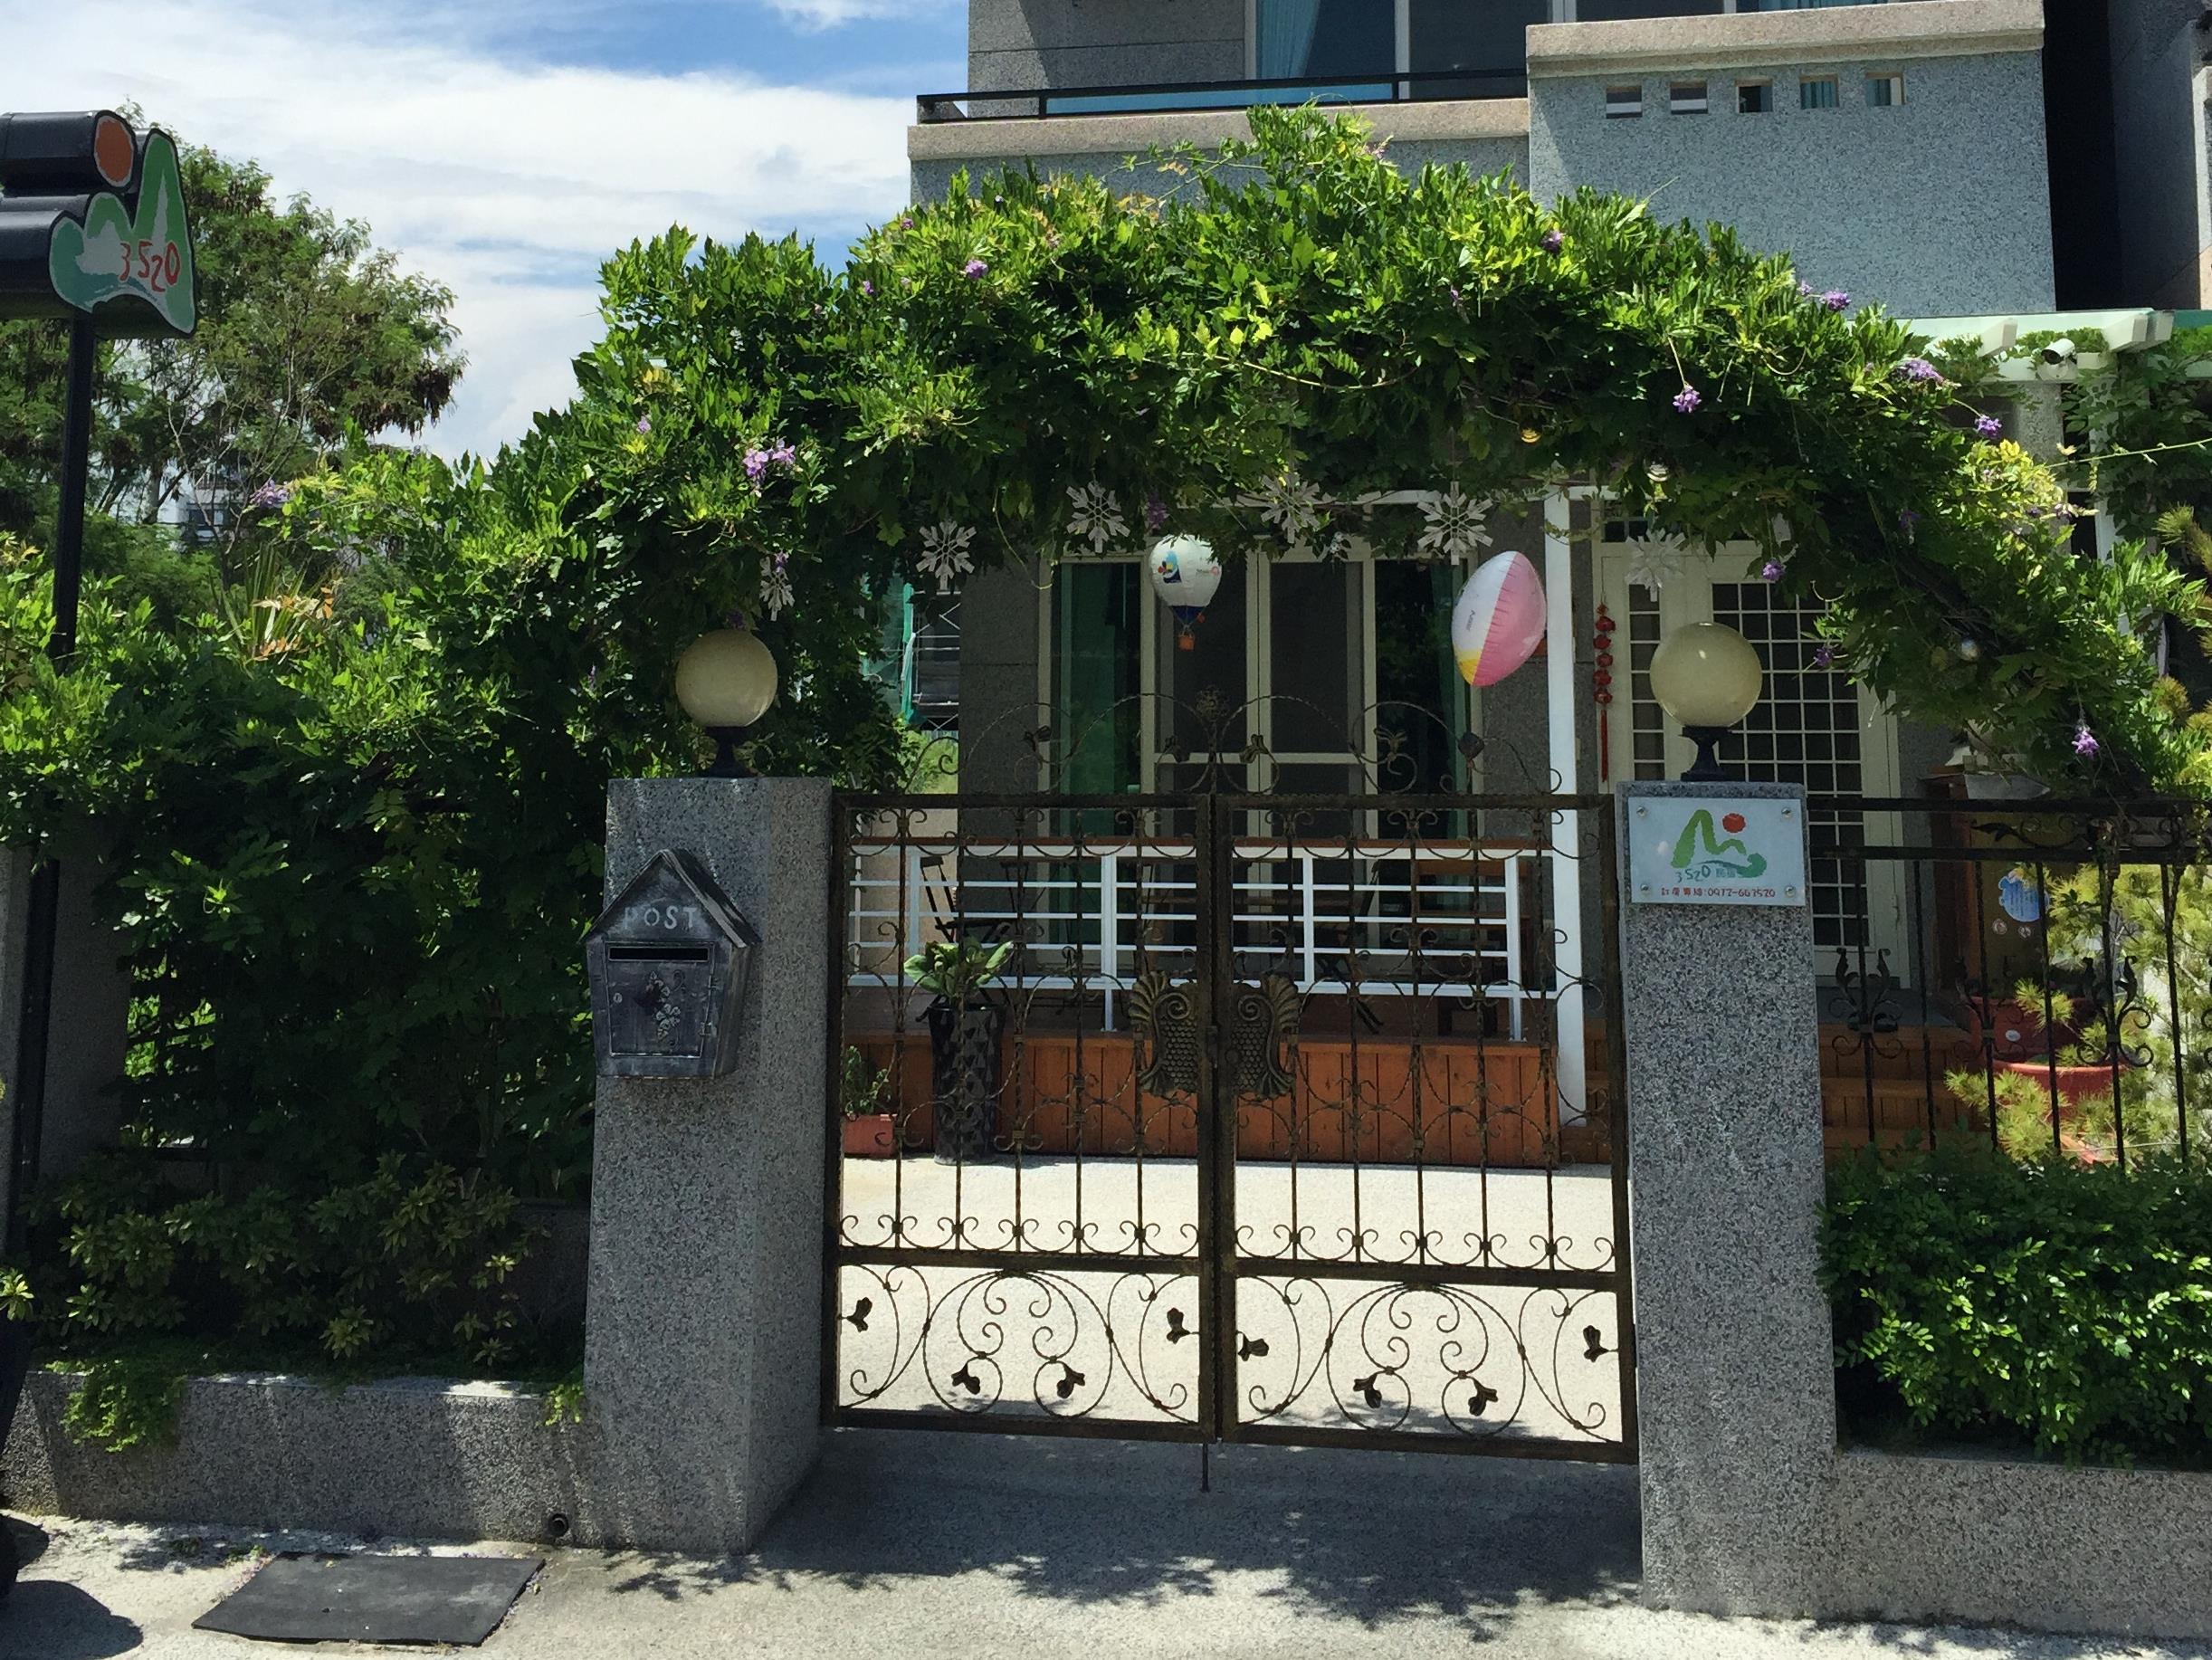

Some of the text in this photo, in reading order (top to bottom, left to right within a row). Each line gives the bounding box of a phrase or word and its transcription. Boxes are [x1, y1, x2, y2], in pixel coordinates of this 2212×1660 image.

[119, 240, 182, 293] 3520
[1675, 864, 1711, 882] 3520
[623, 905, 698, 930] POST
